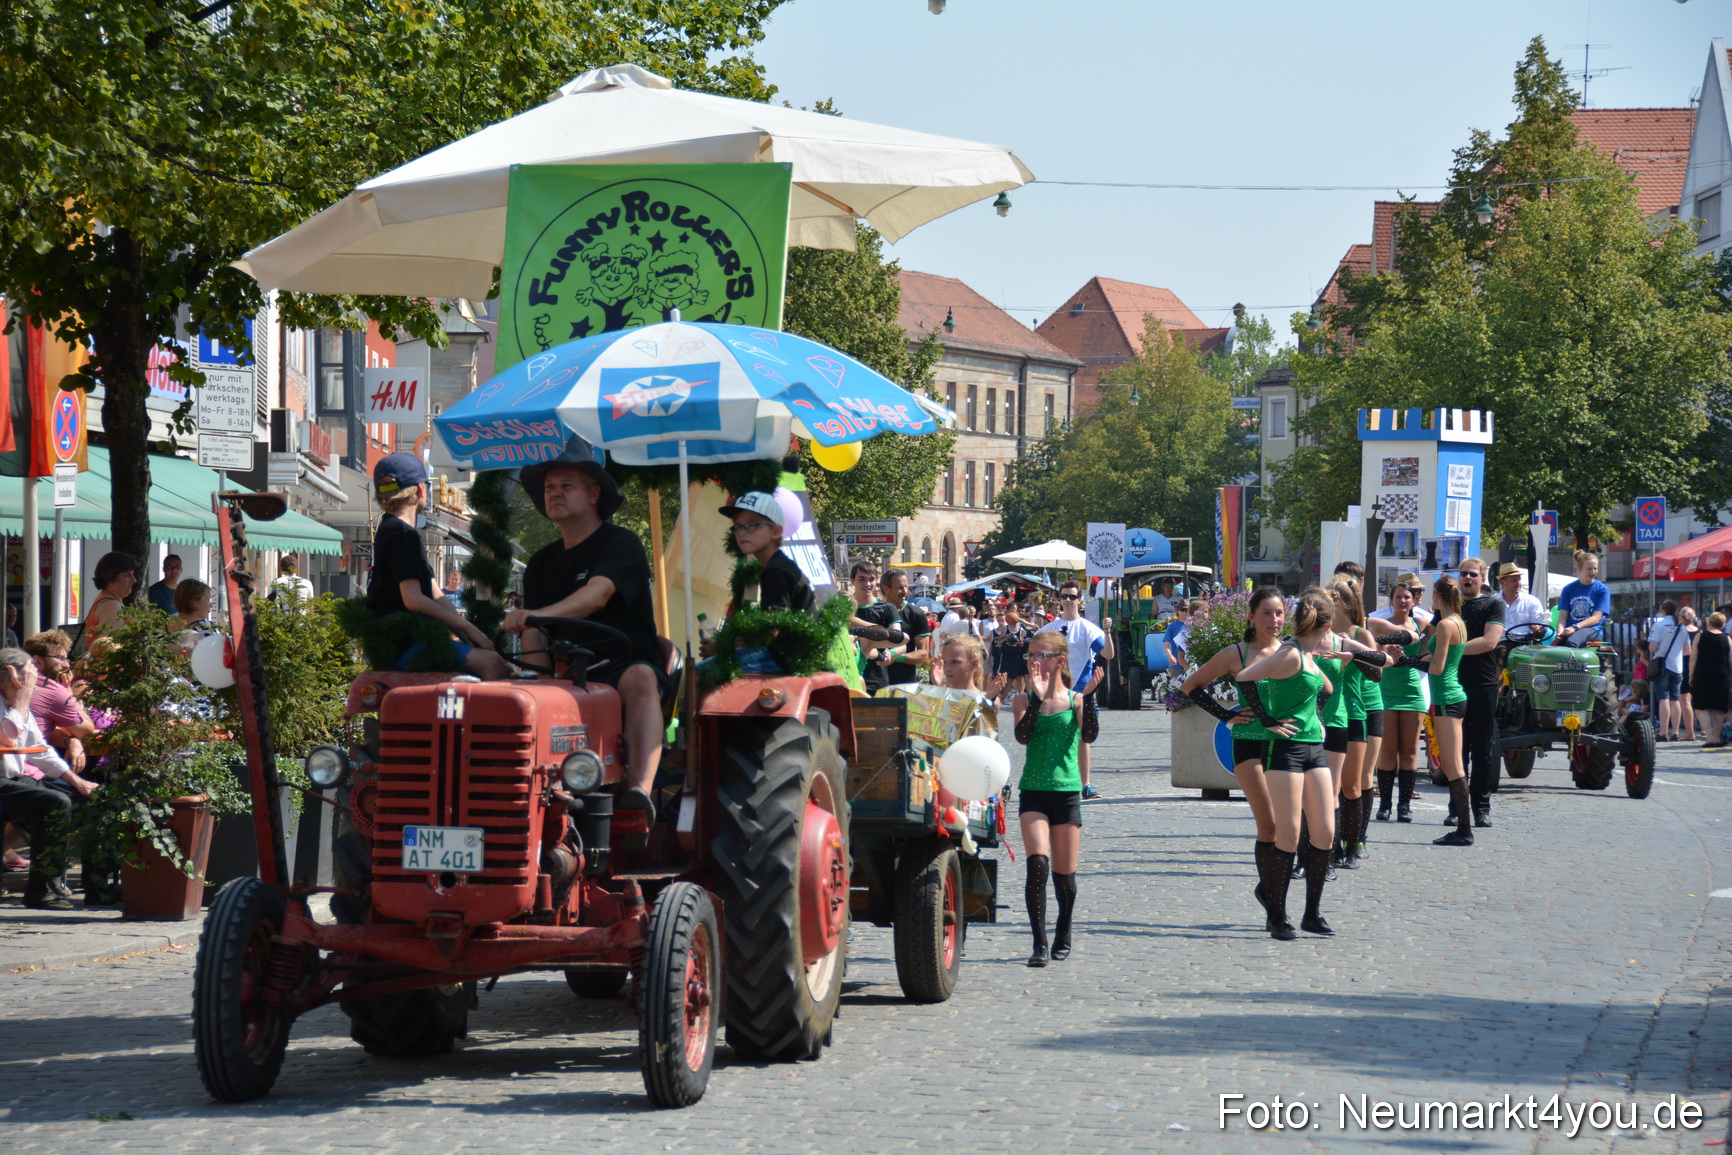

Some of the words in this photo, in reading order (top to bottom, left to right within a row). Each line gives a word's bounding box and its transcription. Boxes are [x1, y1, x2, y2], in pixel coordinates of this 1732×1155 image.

[209, 374, 224, 382] nur
[228, 375, 242, 383] mit
[203, 382, 249, 393] Parkschein
[206, 394, 246, 405] werktags
[371, 380, 418, 411] H&M
[201, 416, 211, 425] Sa
[447, 419, 560, 445] Schöller
[859, 535, 886, 543] Rosengasse
[1088, 531, 1123, 546] SCHACHKLUB
[1639, 529, 1662, 538] TAXI
[1088, 553, 1116, 569] NEUMARKT
[419, 829, 444, 849] NM
[408, 849, 433, 868] AT
[440, 850, 476, 869] 401
